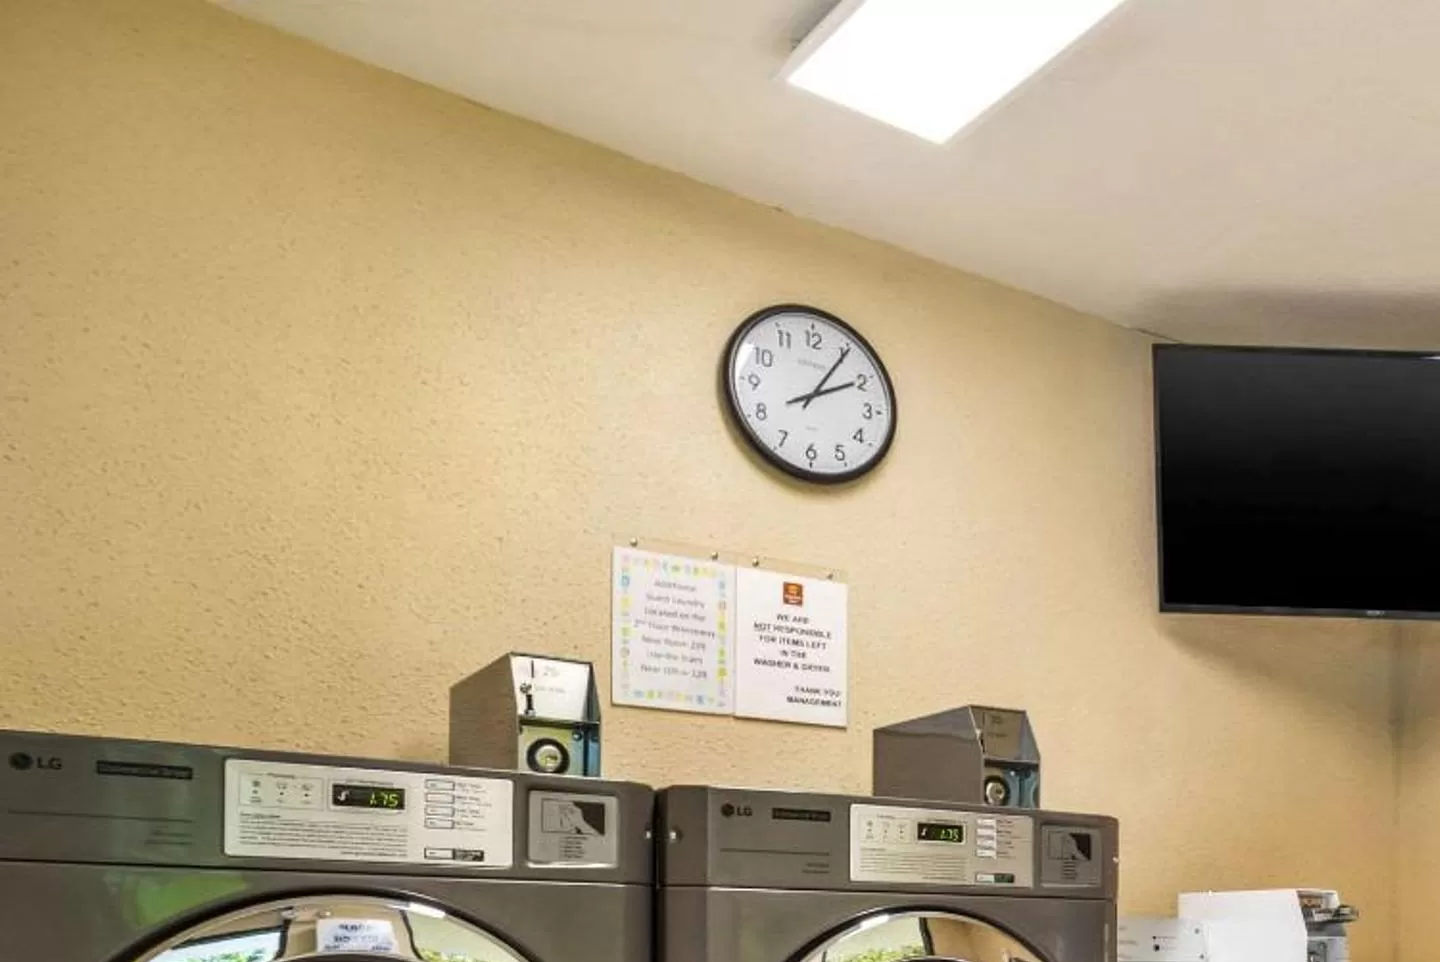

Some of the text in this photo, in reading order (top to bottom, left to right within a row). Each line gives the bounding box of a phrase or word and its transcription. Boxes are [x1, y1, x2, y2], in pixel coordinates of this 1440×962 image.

[777, 329, 792, 349] 11
[804, 329, 823, 350] 12
[754, 346, 773, 367] 10
[748, 373, 761, 391] 9
[856, 373, 868, 392] 2
[755, 402, 767, 421] 8
[862, 402, 873, 420] 3
[778, 429, 788, 448] 7
[852, 428, 865, 444] 4
[805, 443, 818, 461] 6
[834, 444, 846, 462] 5
[776, 613, 809, 625] WE ARE
[753, 622, 832, 640] NOT RESPONSIBLE
[759, 634, 827, 650] FOR ITEMS LEFT
[780, 649, 807, 660] IN THE
[753, 657, 792, 669] WASHER
[801, 663, 831, 673] DRYER
[794, 685, 842, 698] THANK YOU
[786, 695, 842, 707] MANAGEMENT
[36, 756, 64, 770] LG
[369, 792, 400, 807] 1.75
[736, 805, 753, 817] LG
